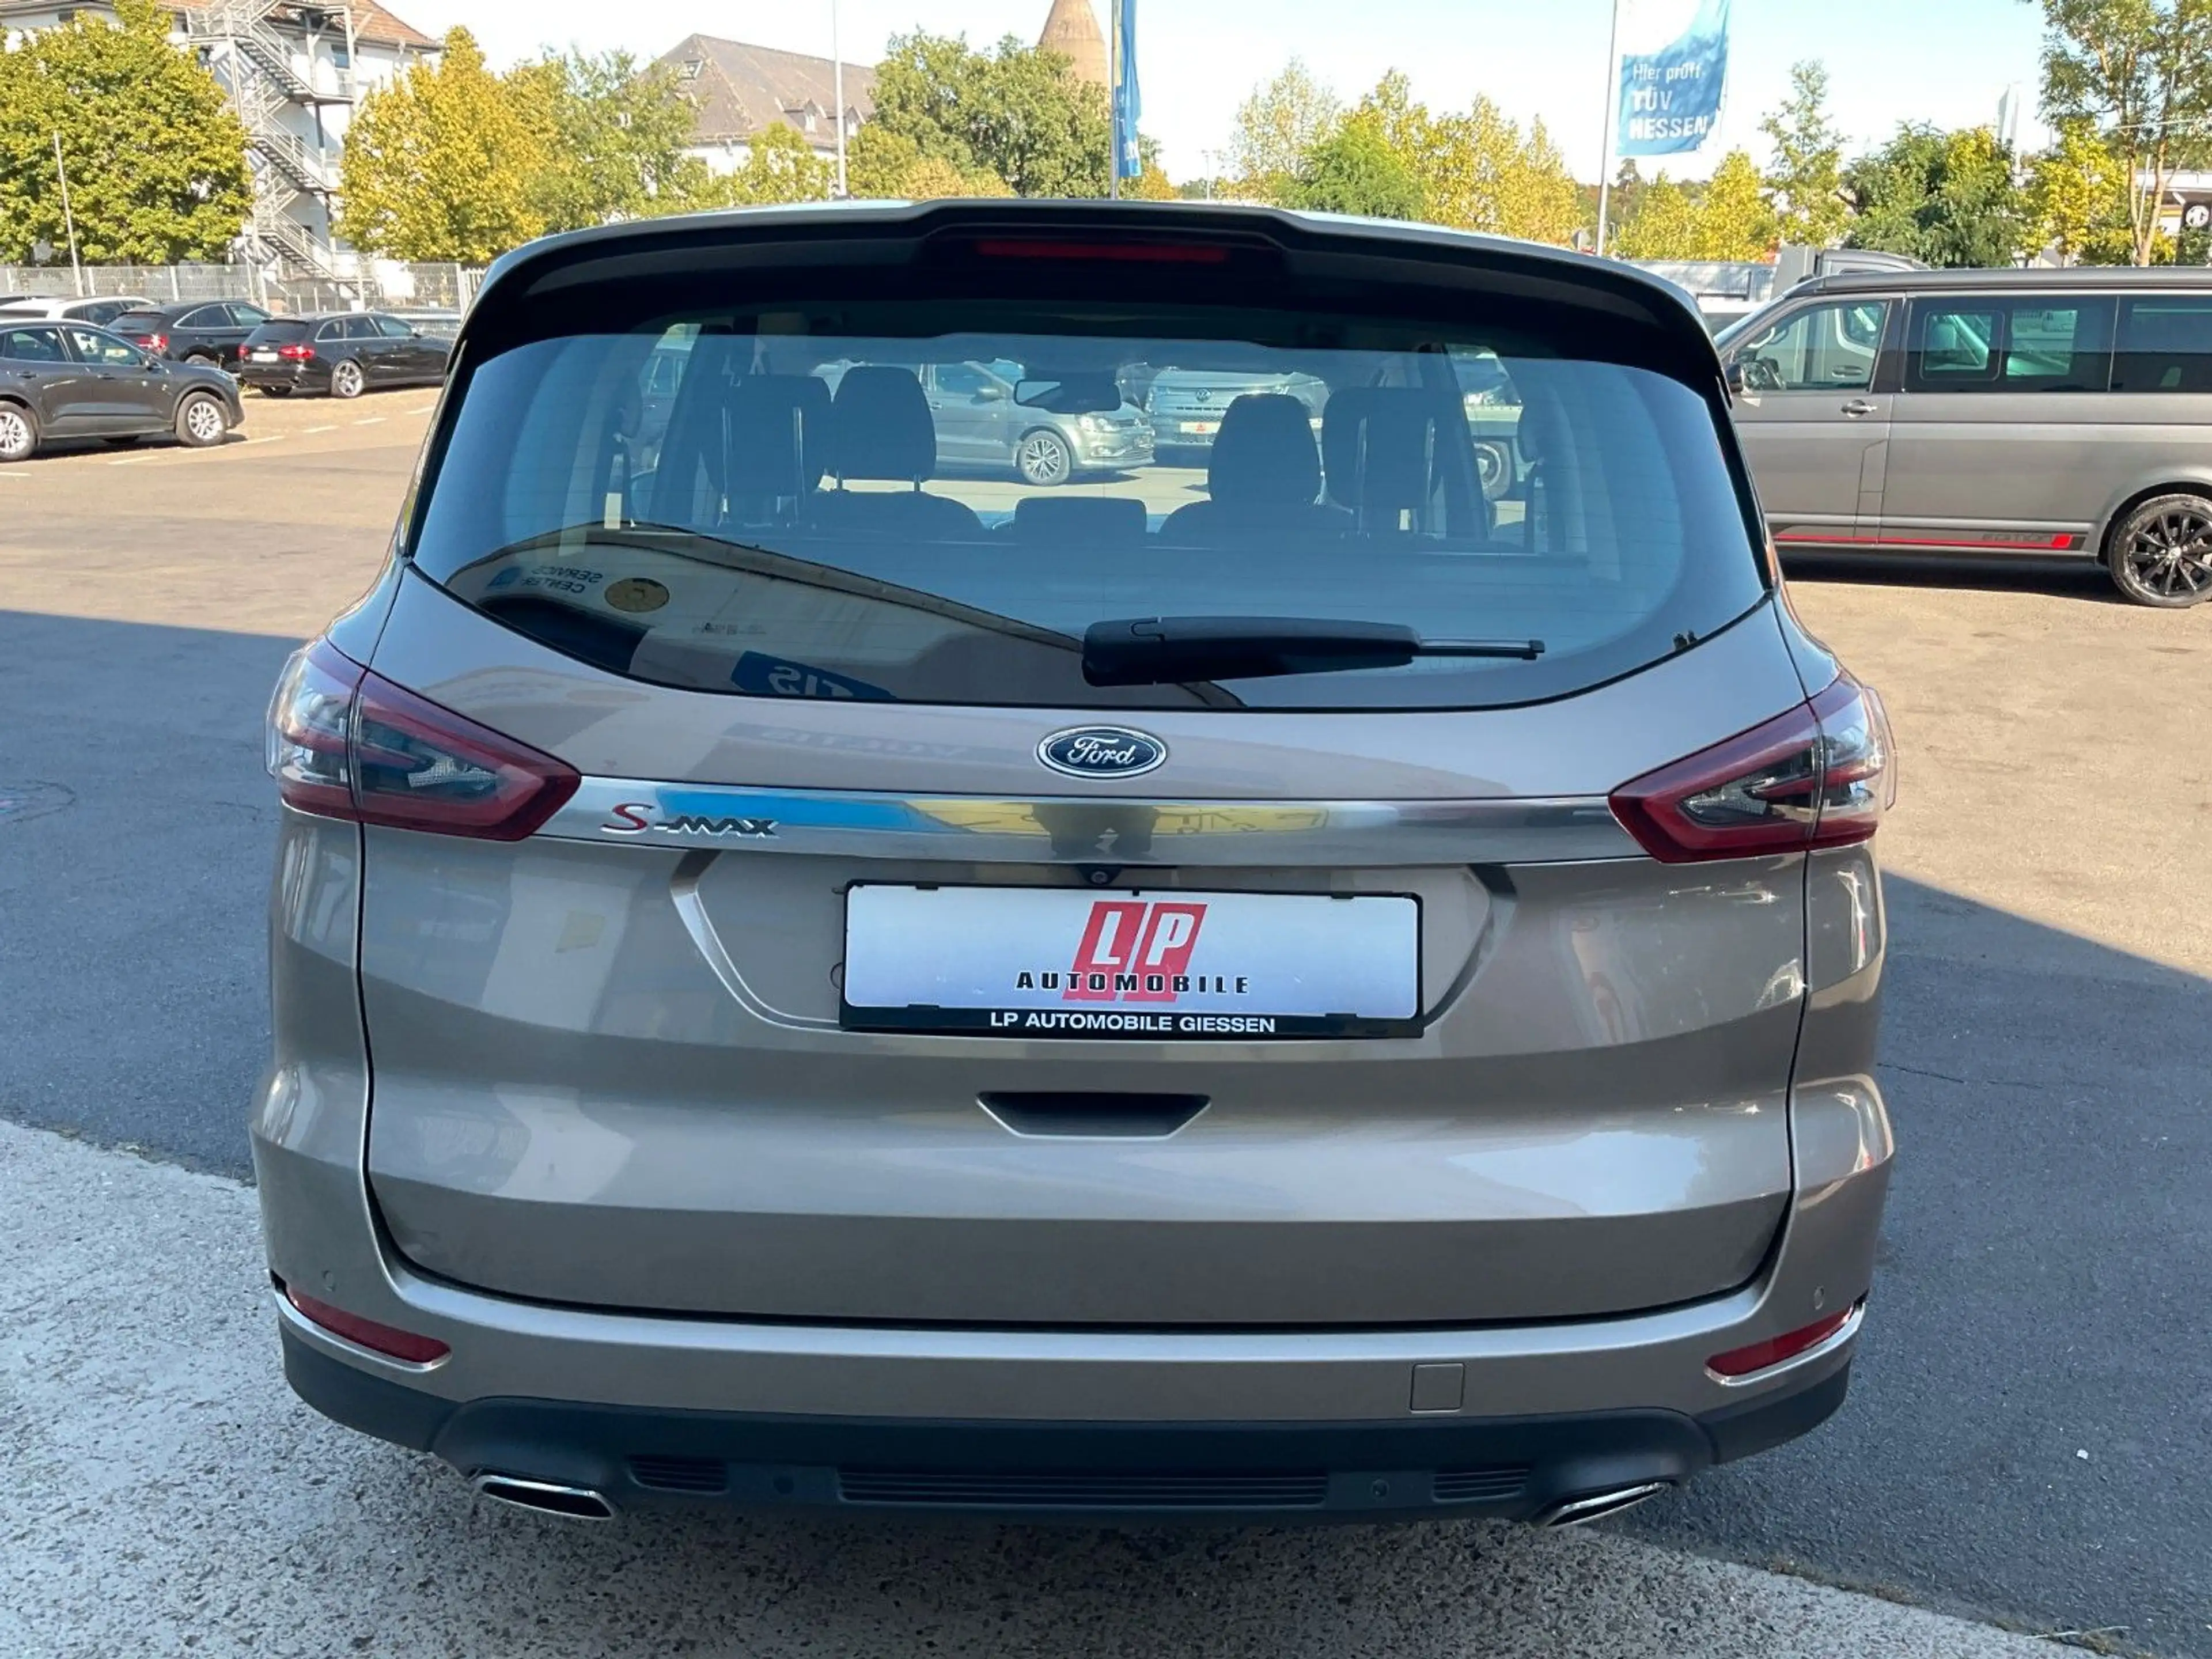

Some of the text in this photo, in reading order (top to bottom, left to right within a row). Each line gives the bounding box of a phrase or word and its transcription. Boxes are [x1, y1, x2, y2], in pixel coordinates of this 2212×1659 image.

[1633, 63, 1660, 81] Hier
[1631, 85, 1672, 111] TÜV
[1629, 116, 1709, 140] HESSEN
[1067, 736, 1137, 765] Ford
[600, 802, 779, 838] S-MAX
[1090, 910, 1195, 967] LP
[1016, 971, 1250, 994] AUTOMOBILE
[991, 1012, 1276, 1033] LP AUTOMOBILE GIESSEN
